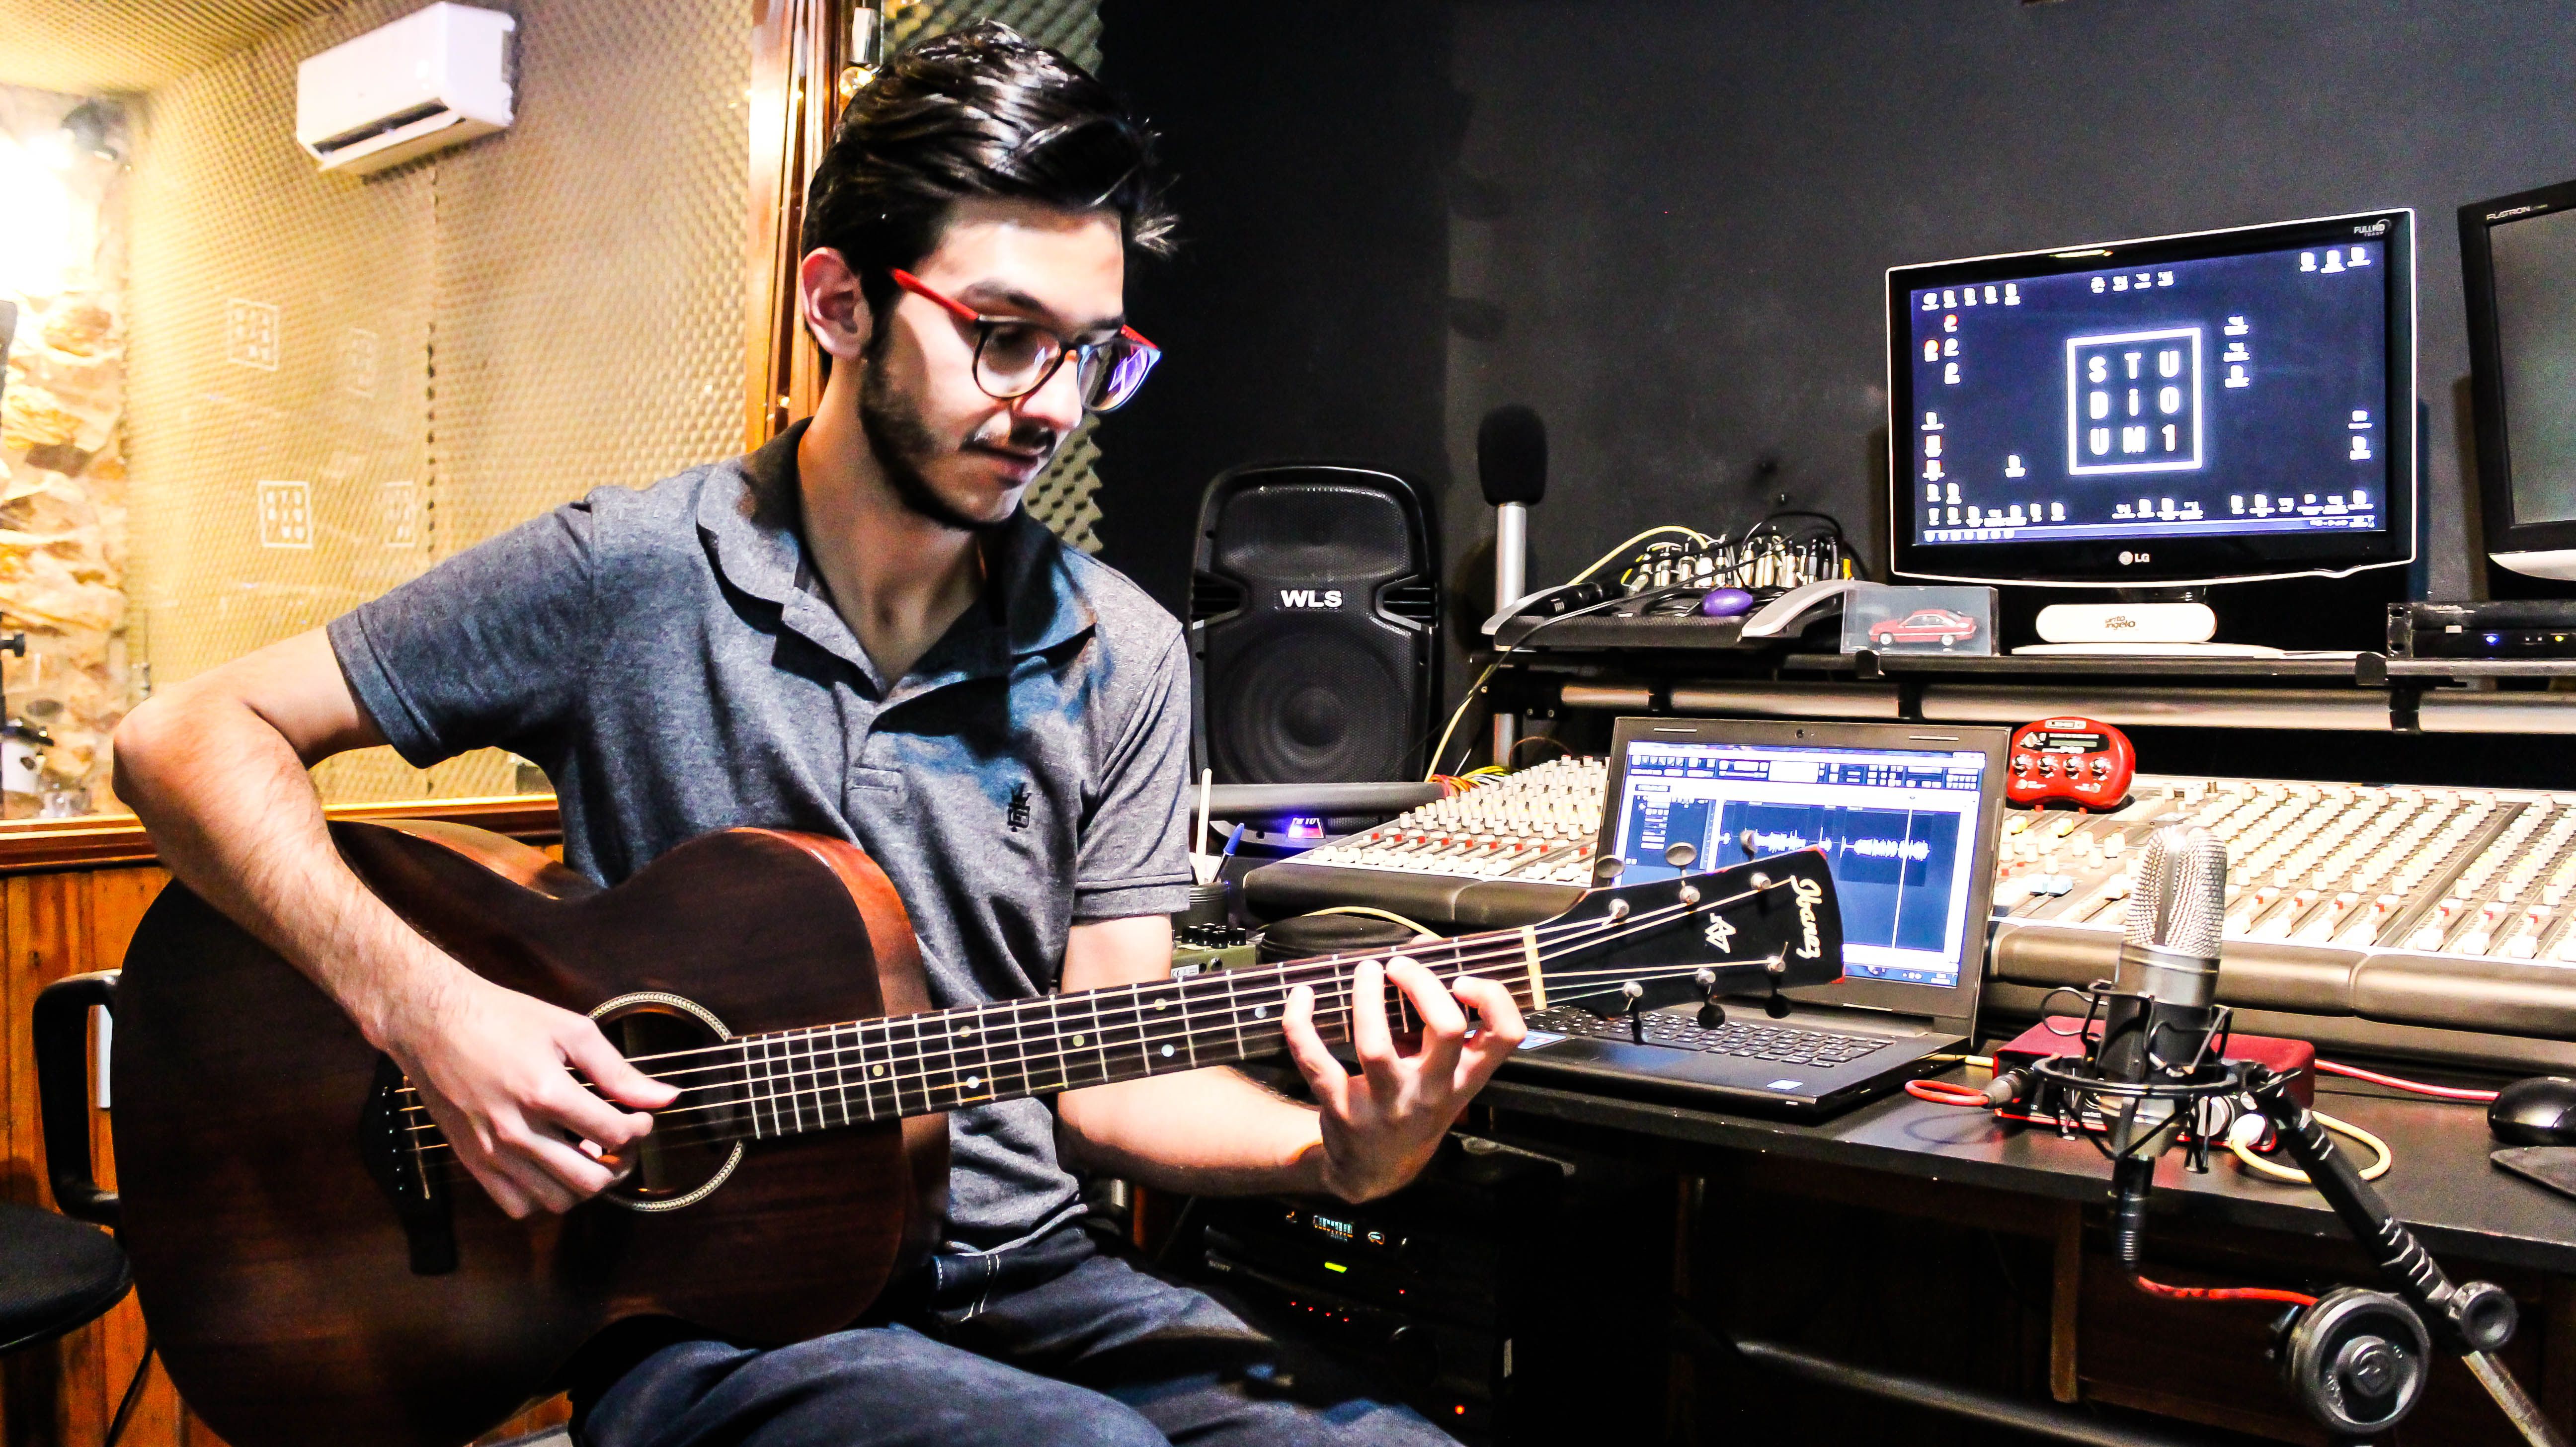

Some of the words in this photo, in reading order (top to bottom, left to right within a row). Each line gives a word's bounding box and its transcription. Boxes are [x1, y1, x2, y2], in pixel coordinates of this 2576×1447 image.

[2134, 553, 2150, 563] LG
[1281, 590, 1343, 607] WLS
[1790, 875, 1822, 959] Ibanez
